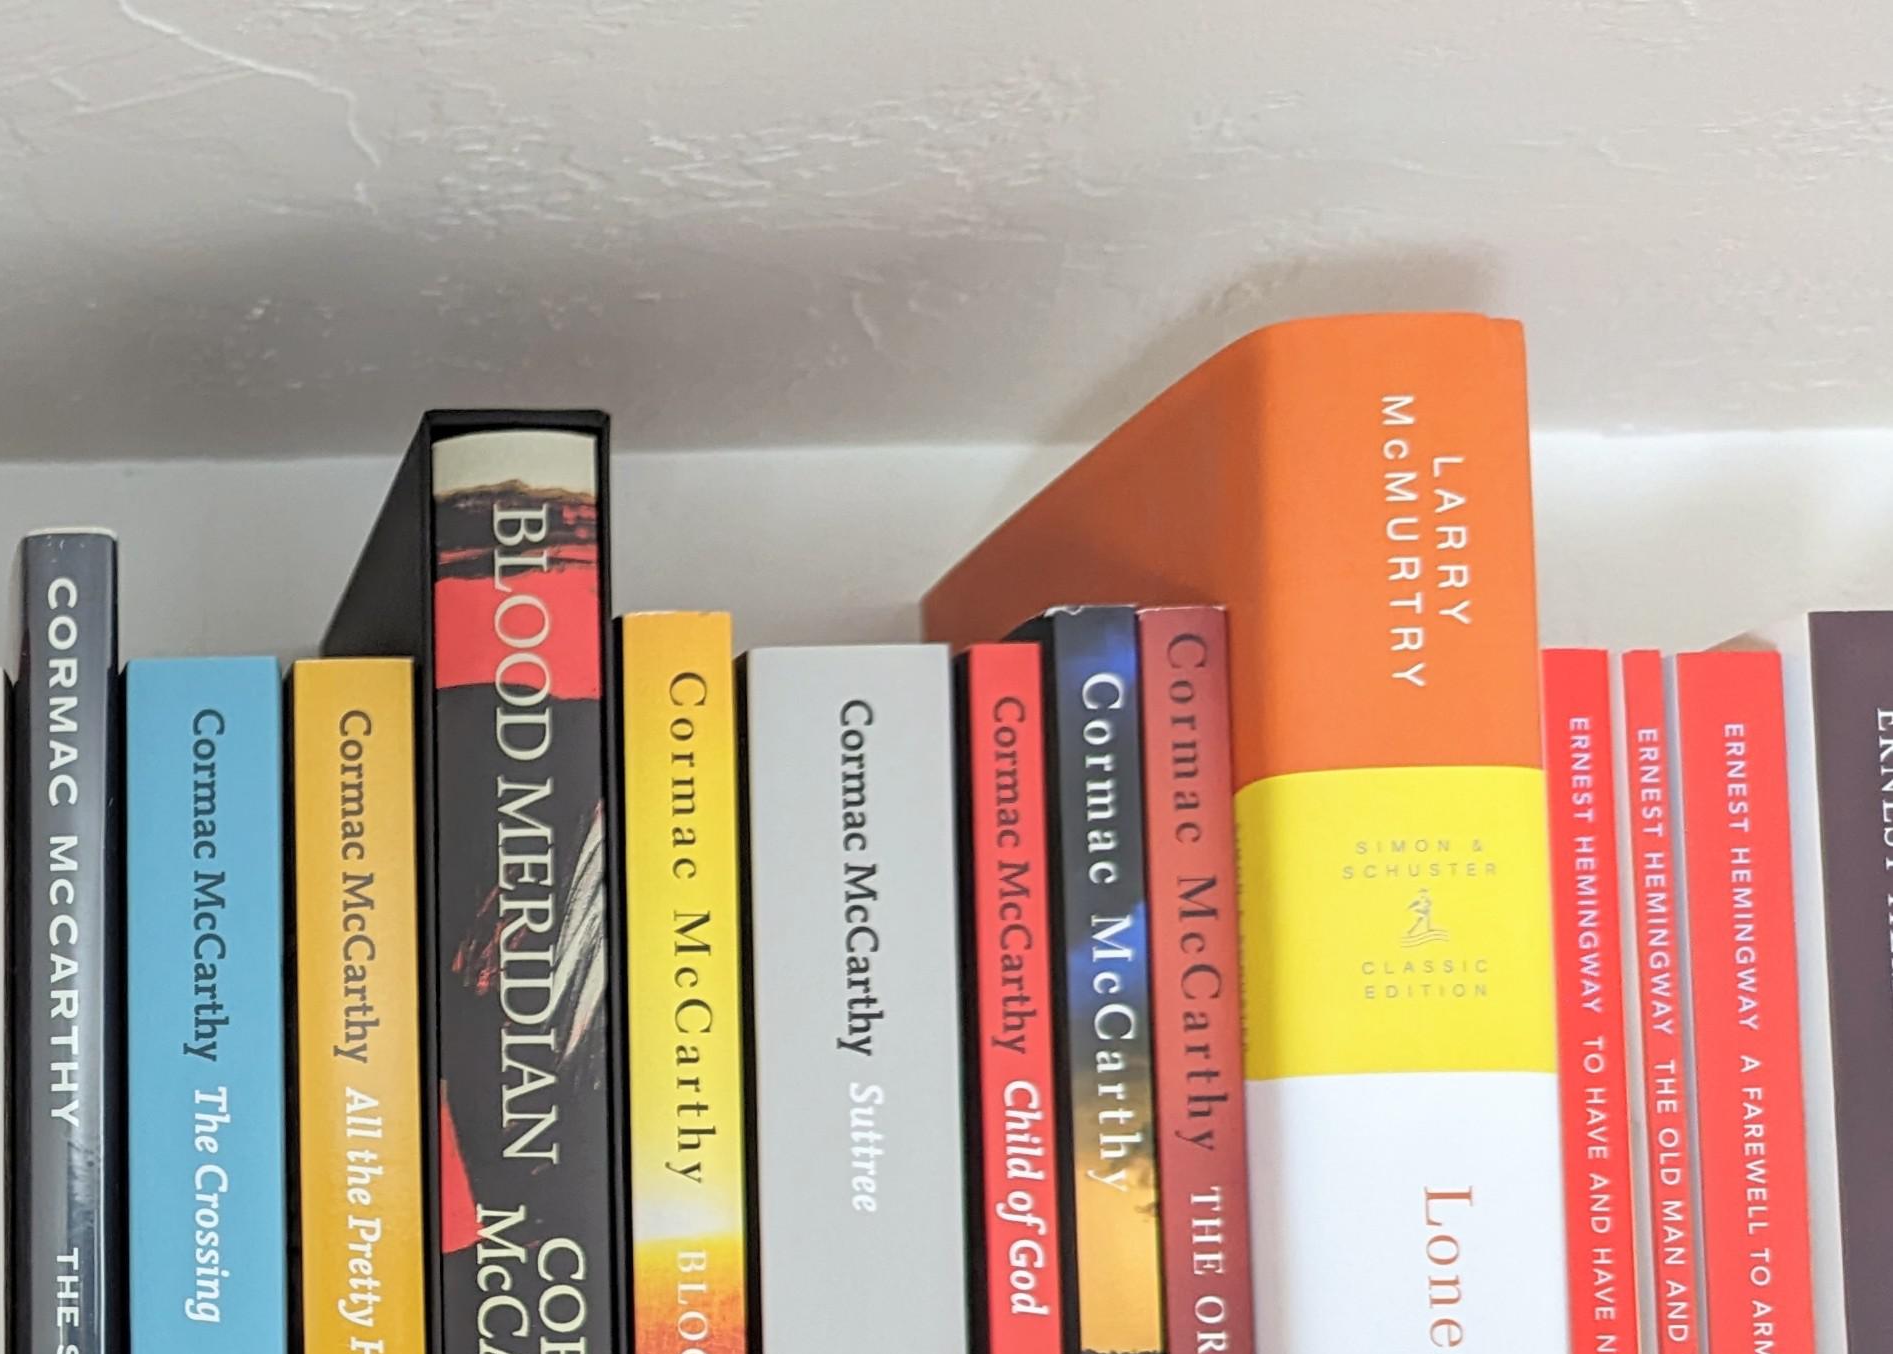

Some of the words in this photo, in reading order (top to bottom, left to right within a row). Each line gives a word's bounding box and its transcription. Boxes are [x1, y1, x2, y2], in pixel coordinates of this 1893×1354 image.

[1382, 395, 1425, 688] McMURTRY
[1434, 454, 1472, 624] LARRY
[47, 577, 78, 806] CORMAC
[491, 504, 554, 761] BLOOD
[191, 709, 225, 859] Cormac
[339, 709, 372, 859] Cormac
[668, 671, 708, 880] Cormac
[840, 700, 874, 852] Cormac
[993, 696, 1026, 847] Cormac
[1082, 672, 1124, 884] Cormac
[1167, 633, 1206, 843] Cormac
[1569, 717, 1594, 822] ERNEST
[1638, 728, 1664, 837] ERNEST
[1724, 723, 1750, 832] ERNEST
[1341, 862, 1498, 878] SCHUSTER
[1356, 840, 1448, 854] SIMON
[49, 835, 80, 1127] McCARTHY
[183, 871, 230, 1062] McCarthy
[333, 873, 380, 1064] McCarthy
[496, 776, 561, 1165] MERIDIAN
[837, 864, 885, 1056] McCarthy
[992, 861, 1038, 1054] McCarthy
[1361, 959, 1490, 975] CLASSIC
[1574, 837, 1603, 1014] HEMINGWAY
[1644, 852, 1674, 1035] HEMINGWAY
[1730, 847, 1760, 1030] HEMINGWAY
[665, 909, 715, 1183] McCarthy
[1177, 875, 1230, 1151] McCarthy
[1364, 983, 1488, 999] EDITION
[343, 1087, 384, 1138] All
[1090, 915, 1144, 1191] McCarthy
[1583, 1037, 1605, 1073] TO
[1654, 1060, 1678, 1113] THE
[1740, 1055, 1761, 1073] A
[193, 1086, 232, 1154] The
[343, 1152, 384, 1206] the
[850, 1084, 886, 1212] Suttree
[1003, 1080, 1045, 1180] Child
[1586, 1088, 1610, 1160] HAVE
[1657, 1127, 1682, 1187] OLD
[1741, 1088, 1770, 1235] FAREWELL
[184, 1164, 232, 1323] Crossing
[996, 1190, 1046, 1234] of
[1191, 1186, 1225, 1276] THE
[1589, 1174, 1612, 1234] AND
[1661, 1202, 1684, 1266] MAN
[57, 1248, 79, 1328] THE
[338, 1215, 382, 1329] Pretty
[1008, 1240, 1050, 1316] God
[1592, 1248, 1615, 1320] HAVE
[1666, 1281, 1689, 1342] AND
[1749, 1248, 1774, 1286] TO
